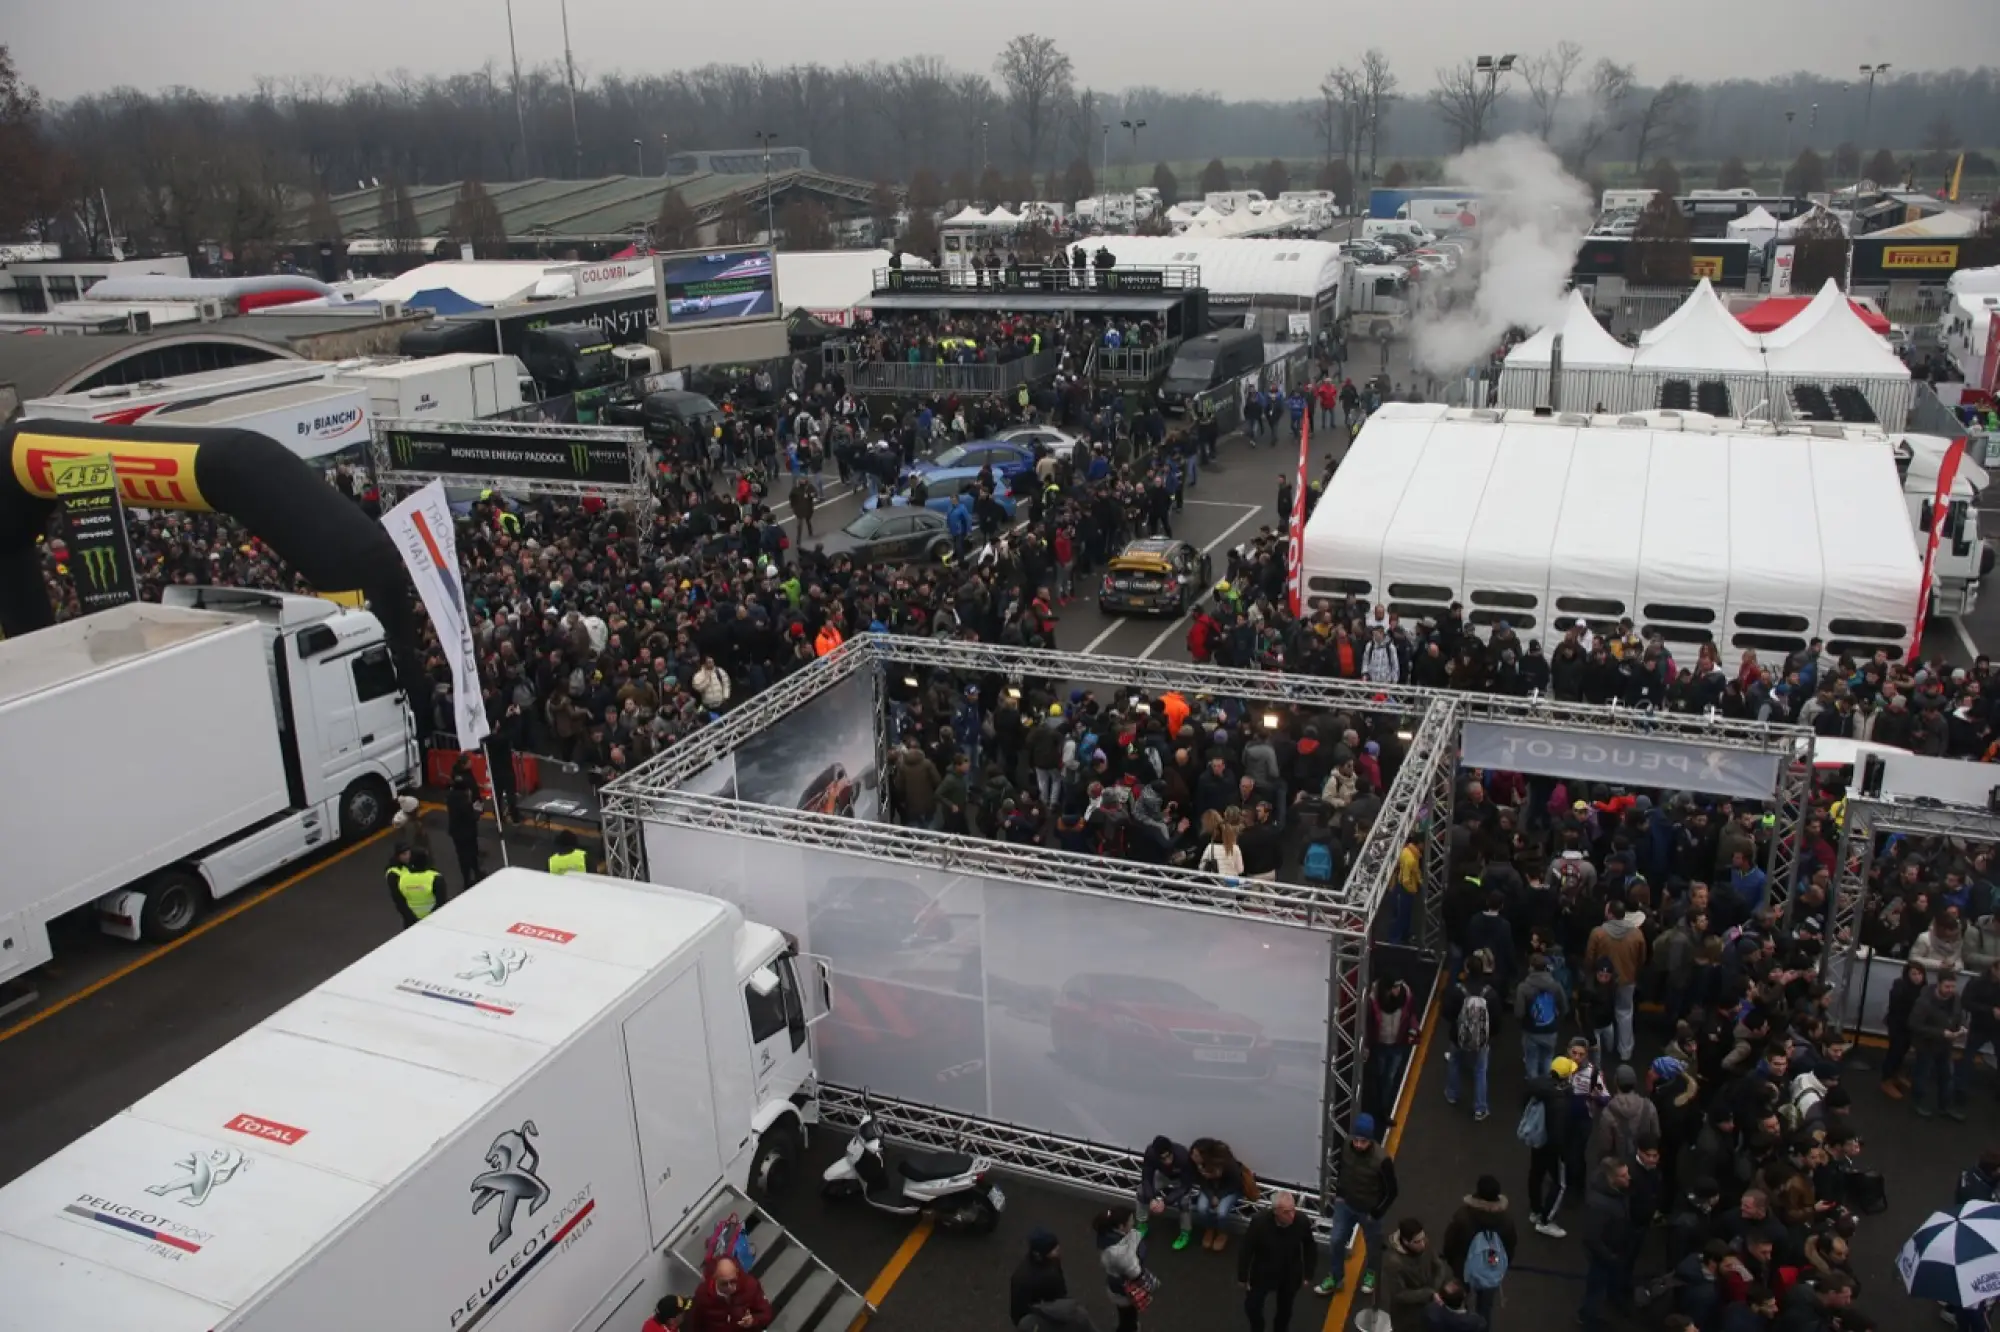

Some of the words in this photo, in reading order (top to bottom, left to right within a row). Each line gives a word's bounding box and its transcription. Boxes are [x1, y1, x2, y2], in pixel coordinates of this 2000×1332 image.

[1888, 251, 1951, 264] PIRELLI
[582, 265, 626, 284] COLOMBI
[297, 422, 311, 436] By
[314, 409, 356, 430] BIANCHI
[451, 448, 490, 460] MONSTER
[492, 451, 525, 462] ENERGY
[525, 452, 566, 464] PADDOCK
[57, 463, 109, 489] 46
[516, 924, 567, 943] TOTAL
[403, 978, 485, 1001] PEUGEOT
[237, 1117, 293, 1141] TOTAL
[76, 1193, 171, 1227] PEUGEOT
[167, 1222, 217, 1243] SPORT
[560, 1217, 594, 1254] ITALIA
[145, 1243, 184, 1262] ITALIA
[450, 1224, 550, 1328] PEUGEOT
[552, 1181, 593, 1229] SPORT
